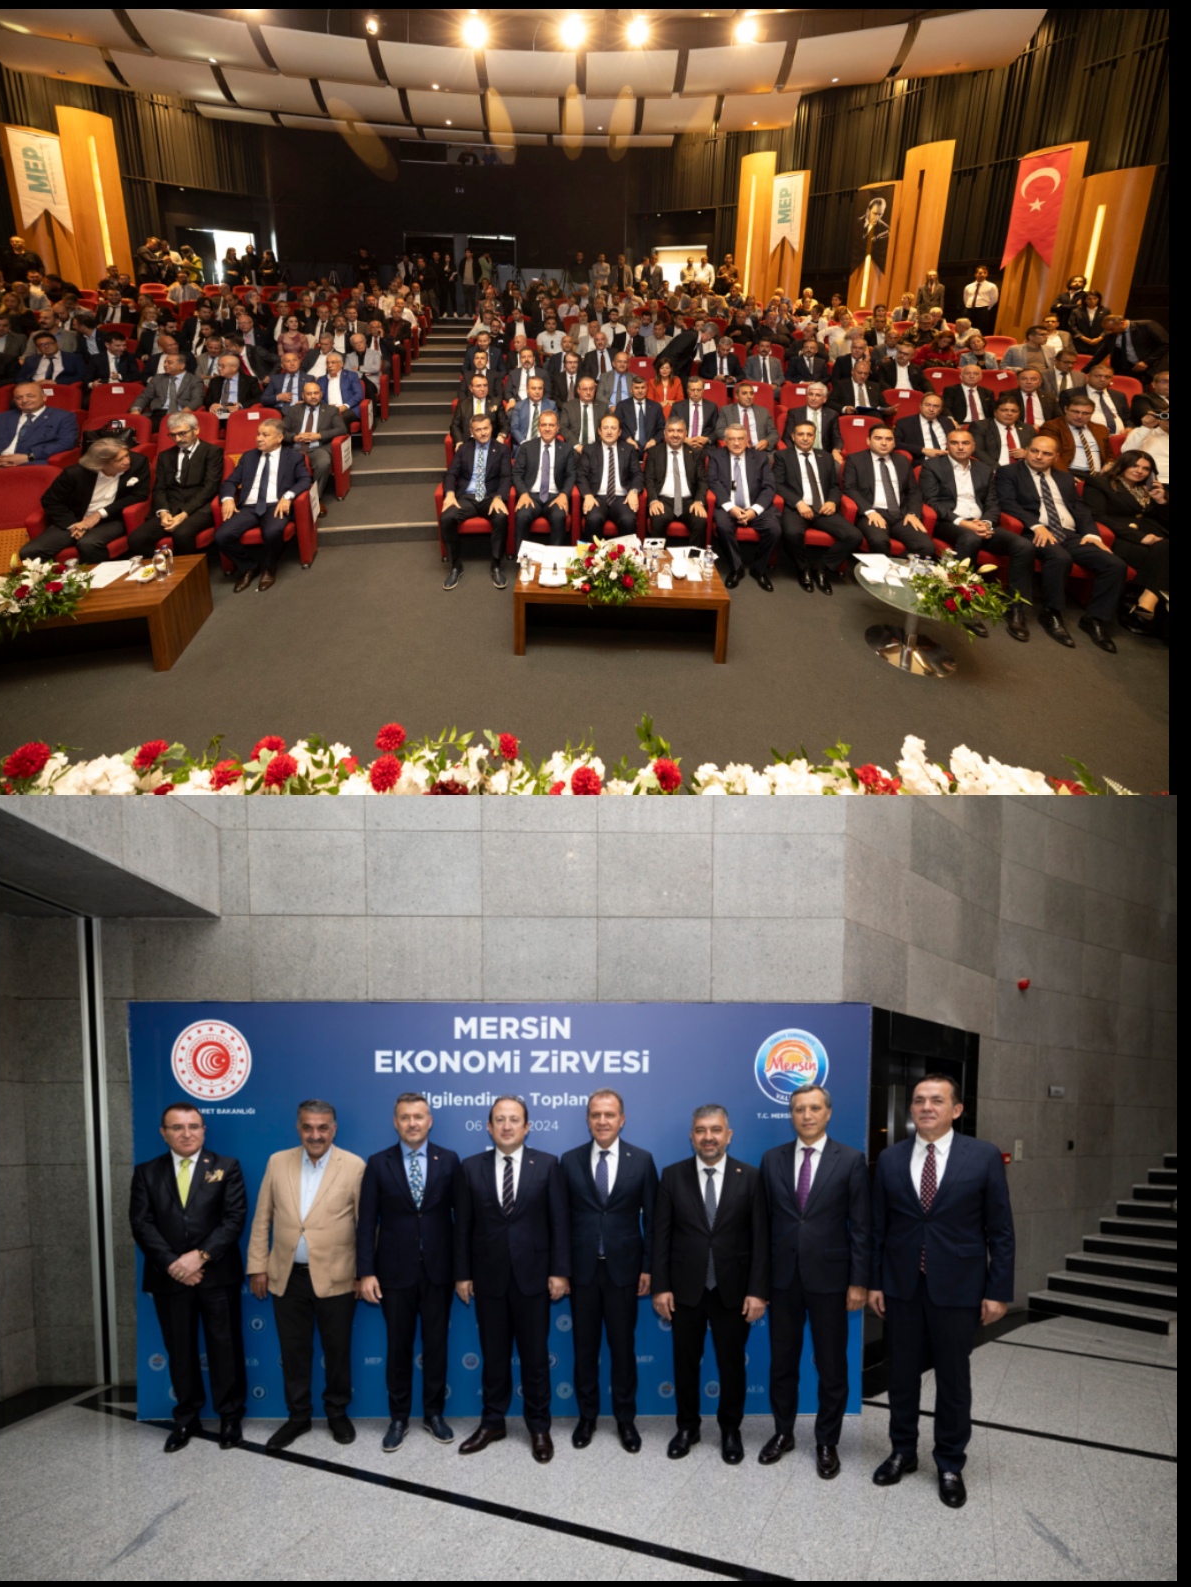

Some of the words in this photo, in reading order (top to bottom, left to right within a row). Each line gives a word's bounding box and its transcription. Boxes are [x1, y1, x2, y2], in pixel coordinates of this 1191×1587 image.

[21, 146, 52, 194] MEP
[777, 187, 792, 224] MEP
[765, 1056, 817, 1073] Mersin
[465, 1120, 482, 1131] 06
[529, 1120, 559, 1131] 2024
